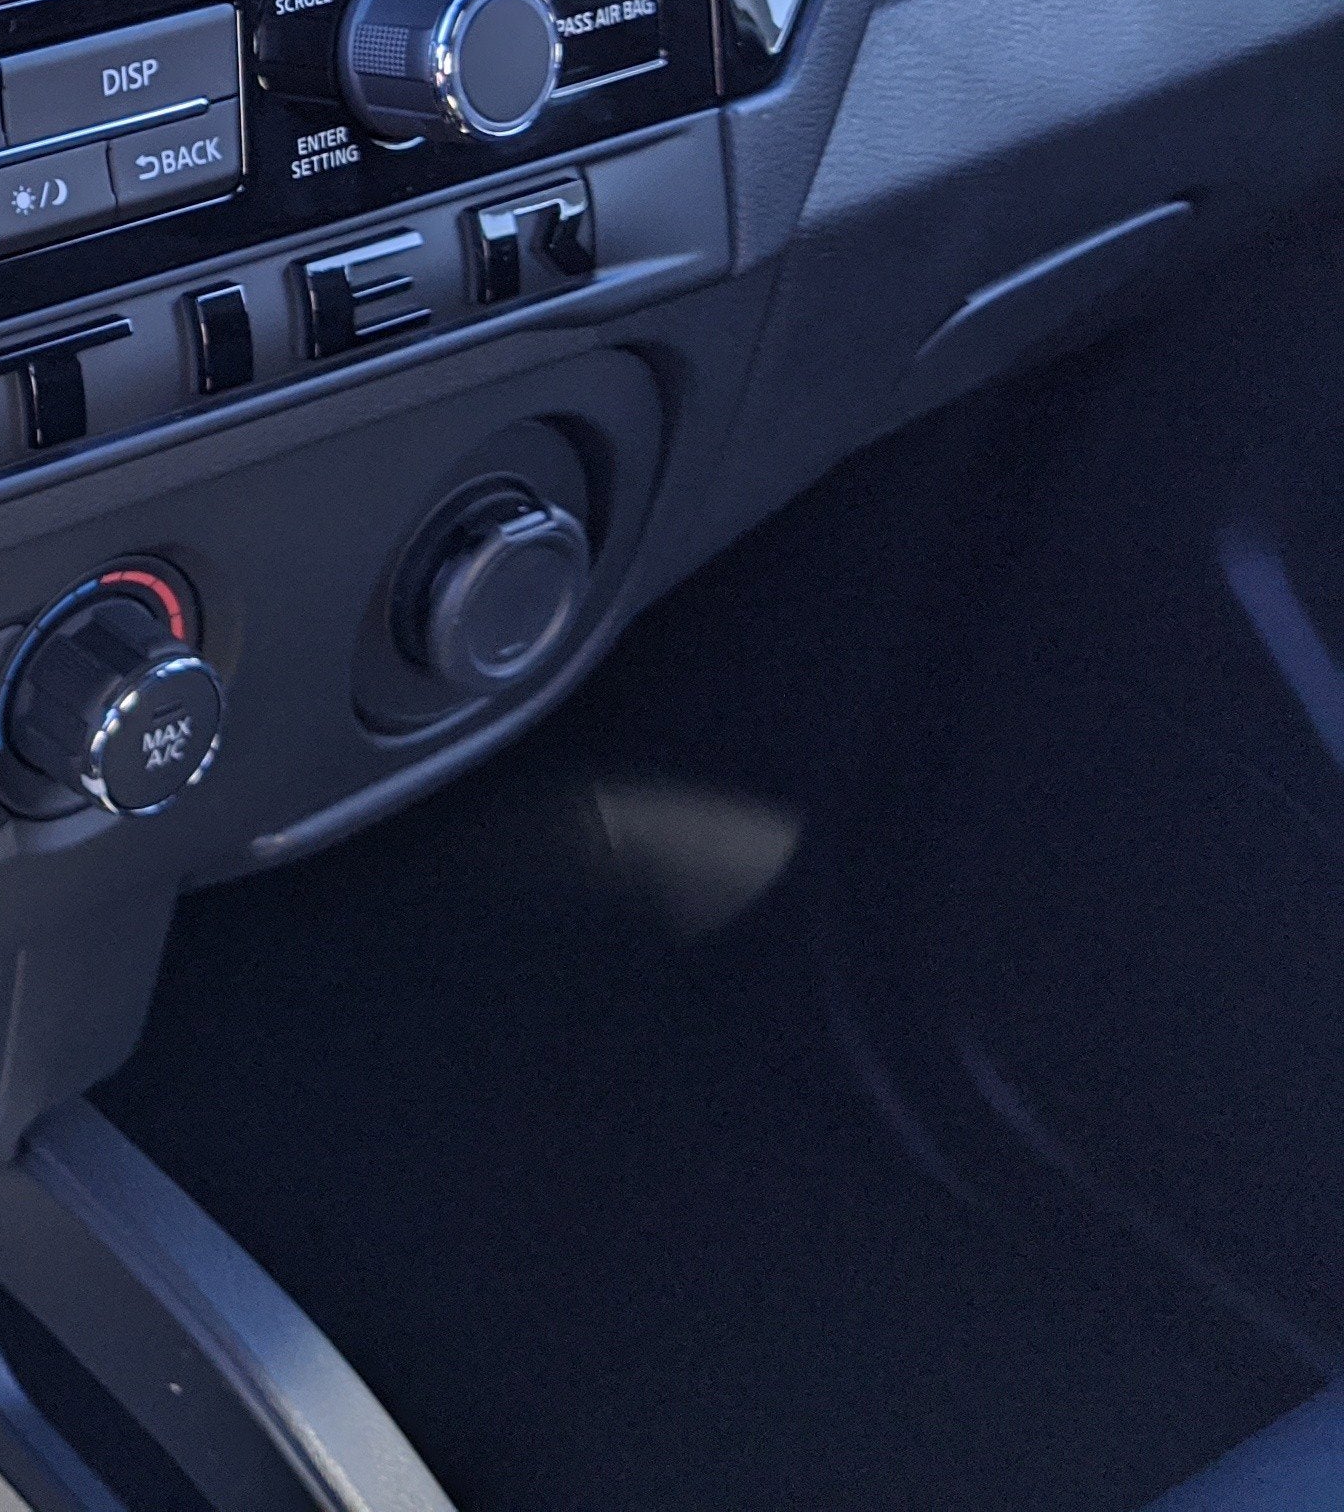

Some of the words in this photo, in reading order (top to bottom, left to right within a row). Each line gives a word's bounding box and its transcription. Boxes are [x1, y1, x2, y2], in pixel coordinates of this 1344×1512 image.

[595, 4, 621, 29] AIR
[101, 59, 158, 95] DISP
[162, 136, 223, 174] BACK
[297, 126, 348, 155] ENTER
[291, 145, 360, 179] SETTING
[142, 716, 191, 752] MAX
[146, 737, 186, 769] A/C
